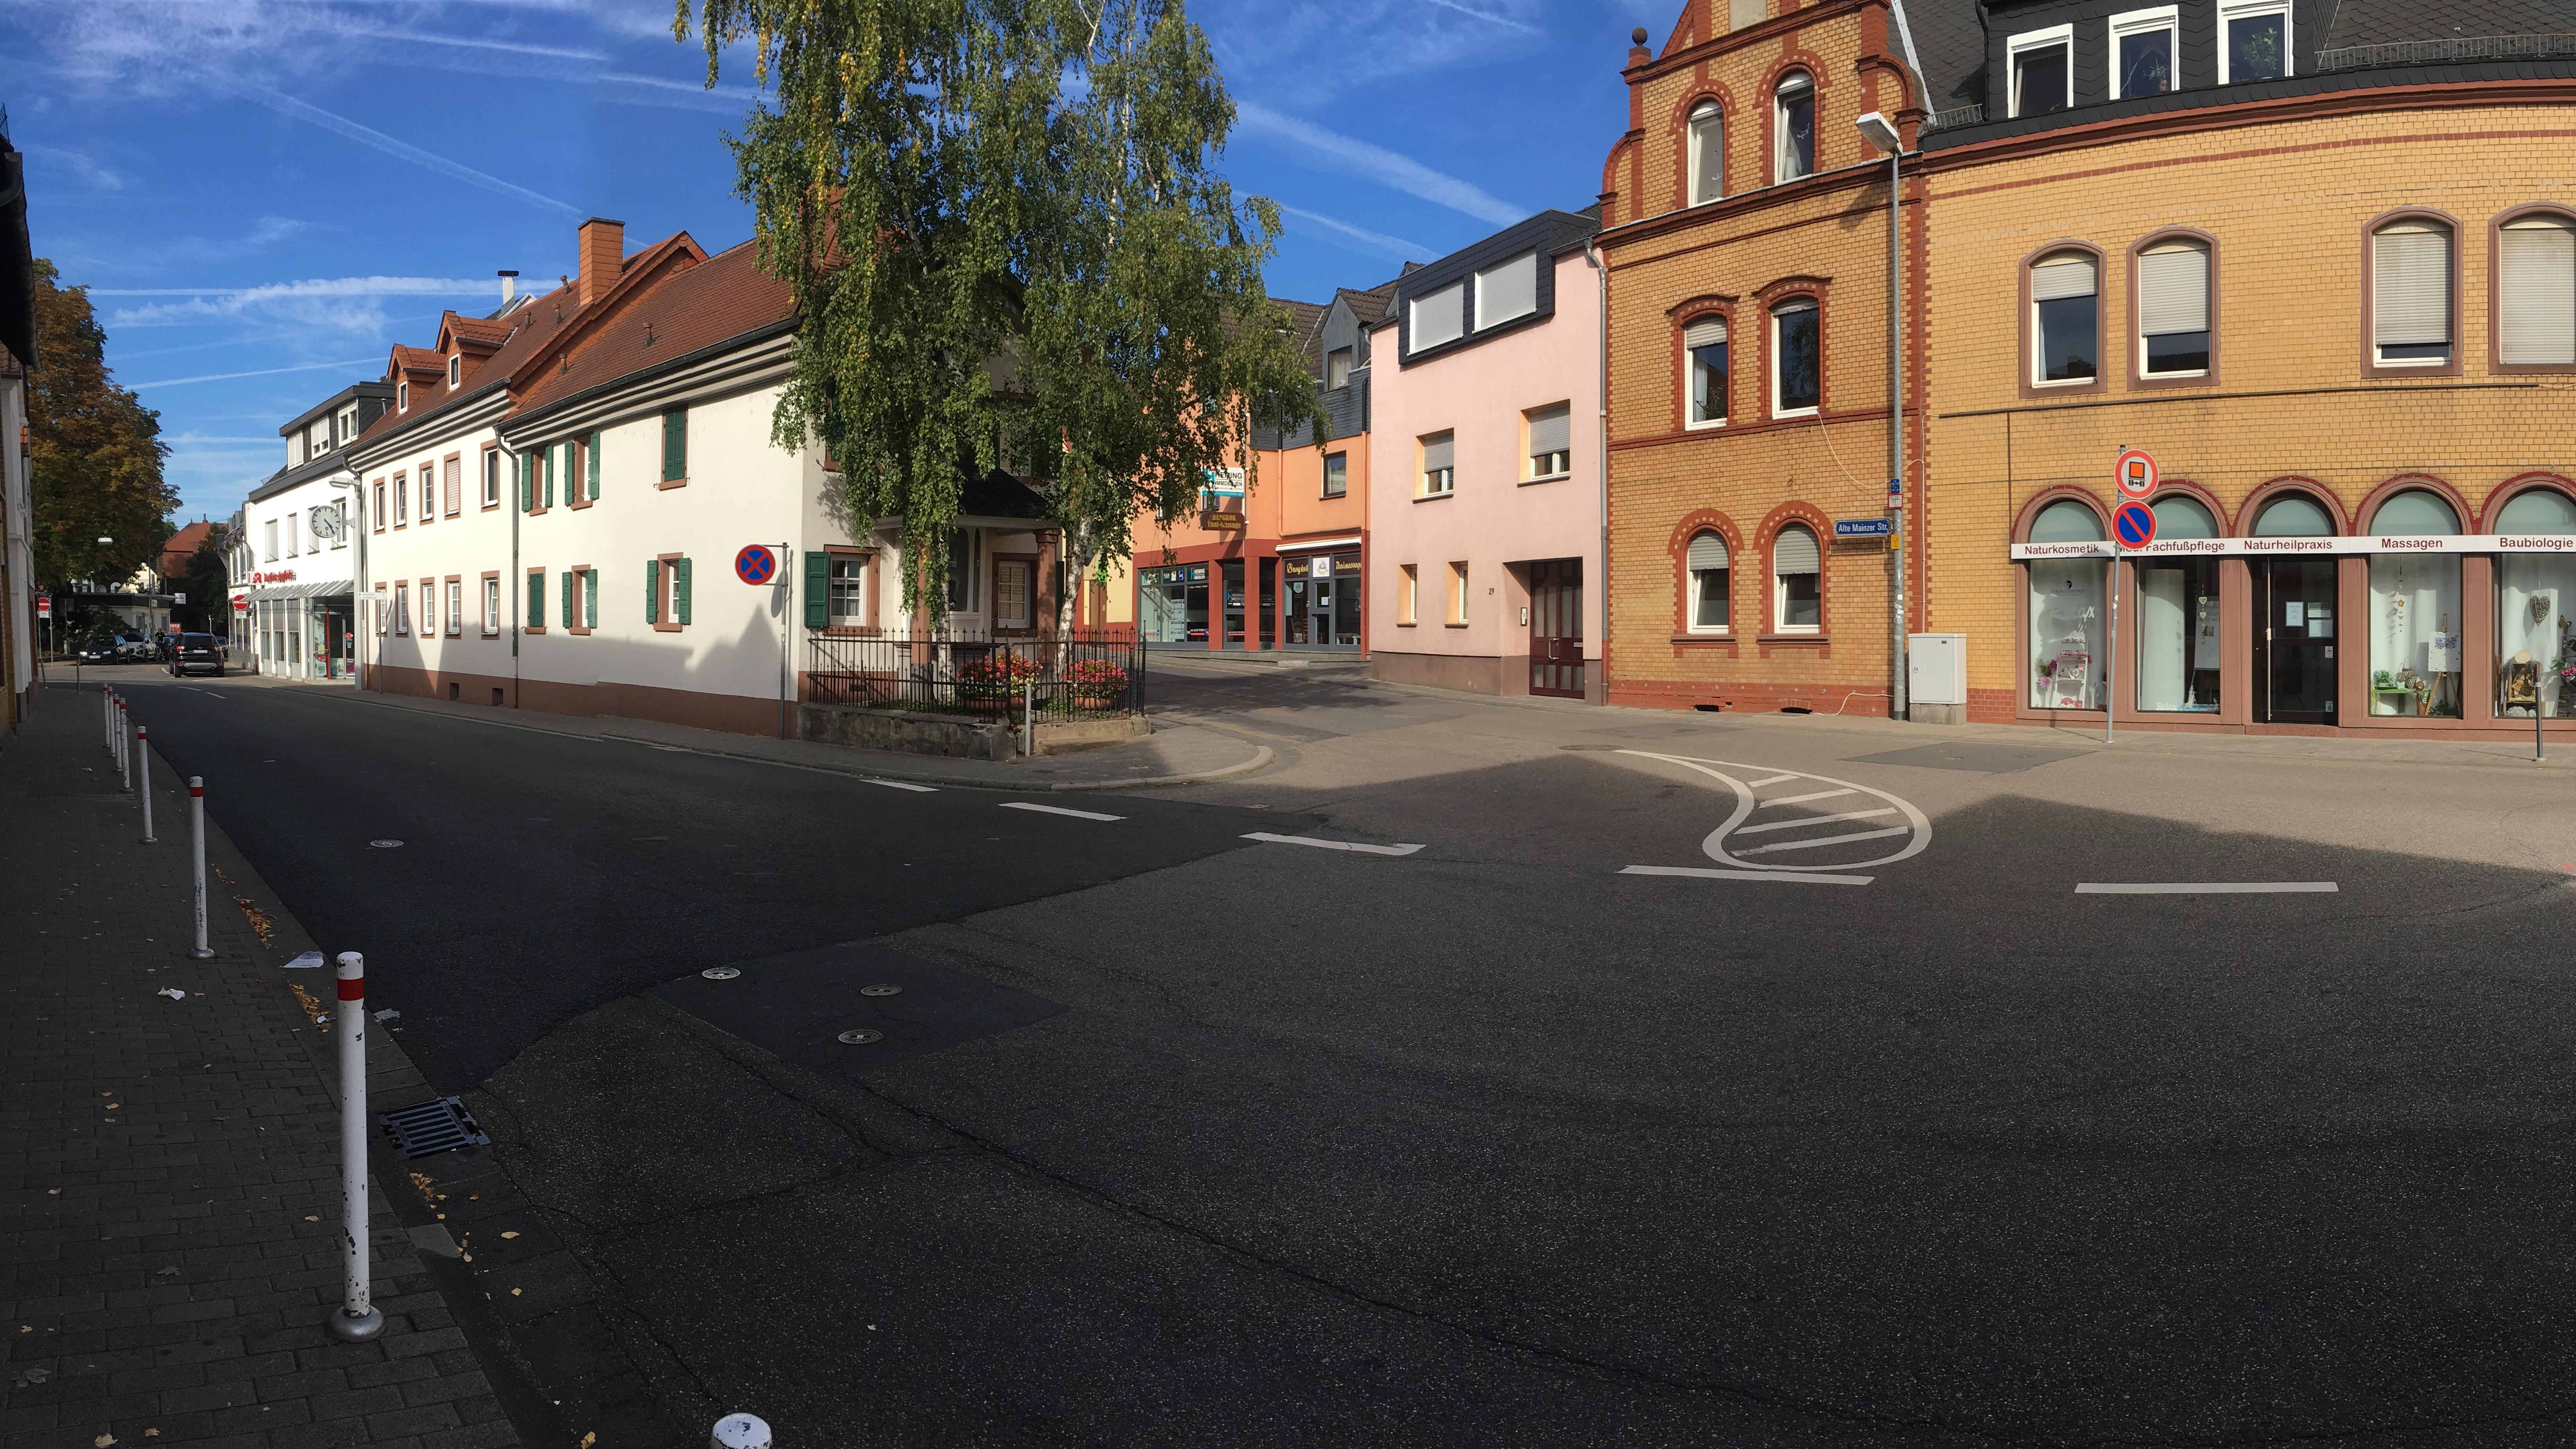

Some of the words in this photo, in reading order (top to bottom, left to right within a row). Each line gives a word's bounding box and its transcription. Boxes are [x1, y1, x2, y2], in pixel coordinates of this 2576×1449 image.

[1852, 524, 1875, 532] Mainzer
[2025, 544, 2099, 554] Naturkosmetik
[2244, 540, 2332, 551] Naturheilpraxis
[2382, 538, 2443, 550] Massagen
[2500, 538, 2573, 550] Baubiologie
[2156, 702, 2178, 711] Relax
